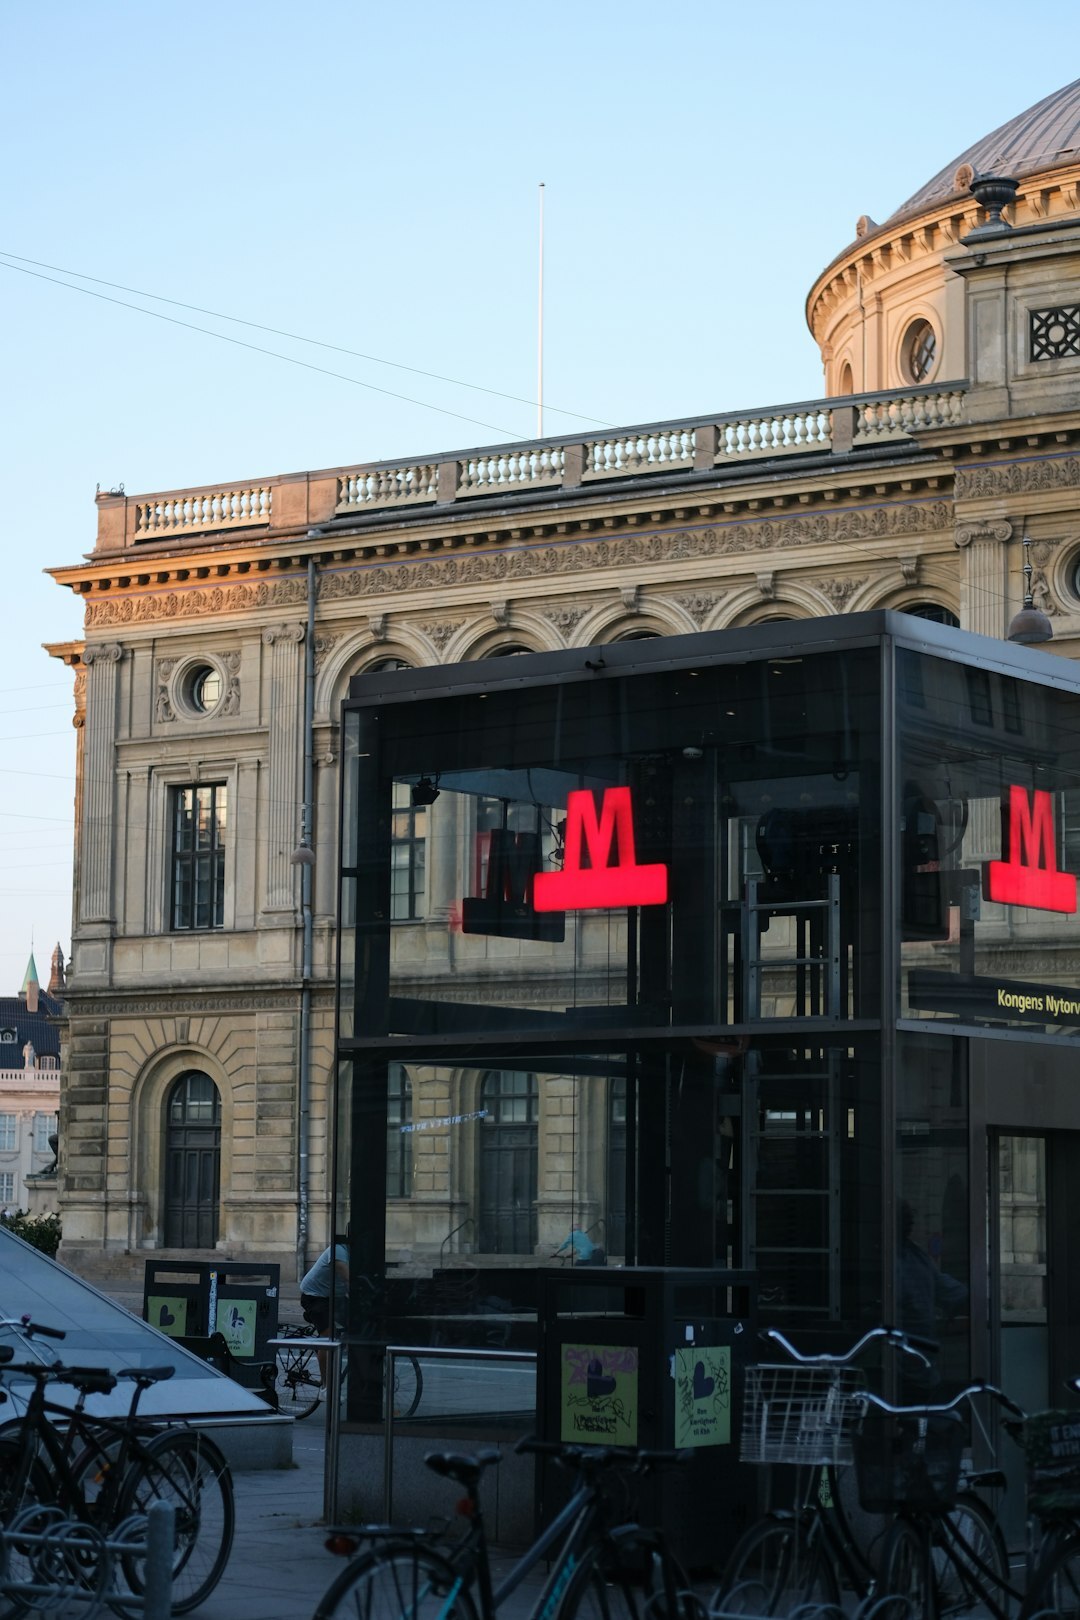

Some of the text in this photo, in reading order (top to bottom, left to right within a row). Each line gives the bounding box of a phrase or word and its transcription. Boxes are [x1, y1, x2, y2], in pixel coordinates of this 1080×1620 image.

[564, 786, 636, 870] M
[1009, 784, 1057, 872] M
[997, 989, 1080, 1017] Kongens Nytorv
